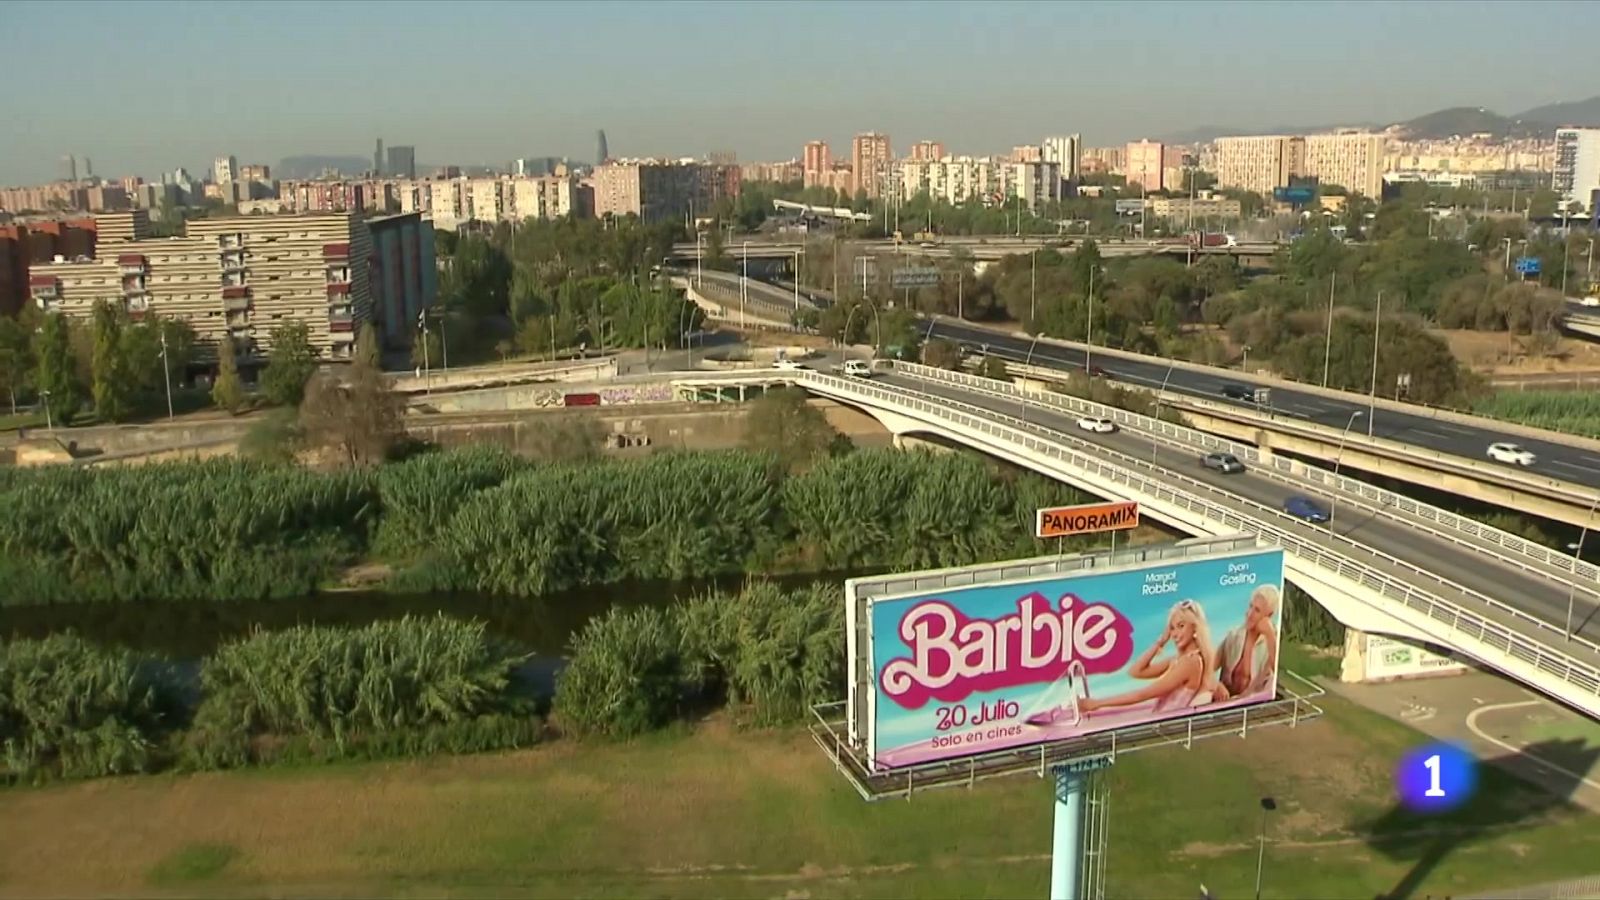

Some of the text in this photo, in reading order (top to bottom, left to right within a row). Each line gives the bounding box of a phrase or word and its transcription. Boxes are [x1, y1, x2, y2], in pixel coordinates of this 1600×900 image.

[1043, 504, 1137, 531] PANORAMIX
[1228, 562, 1249, 574] Ryan
[1146, 571, 1176, 586] Margot
[1219, 572, 1257, 587] Gosling
[1142, 582, 1178, 596] Robbie
[882, 596, 1118, 696] Barbie
[936, 698, 1019, 731] 20 Julio
[932, 724, 1022, 749] Solo en cines
